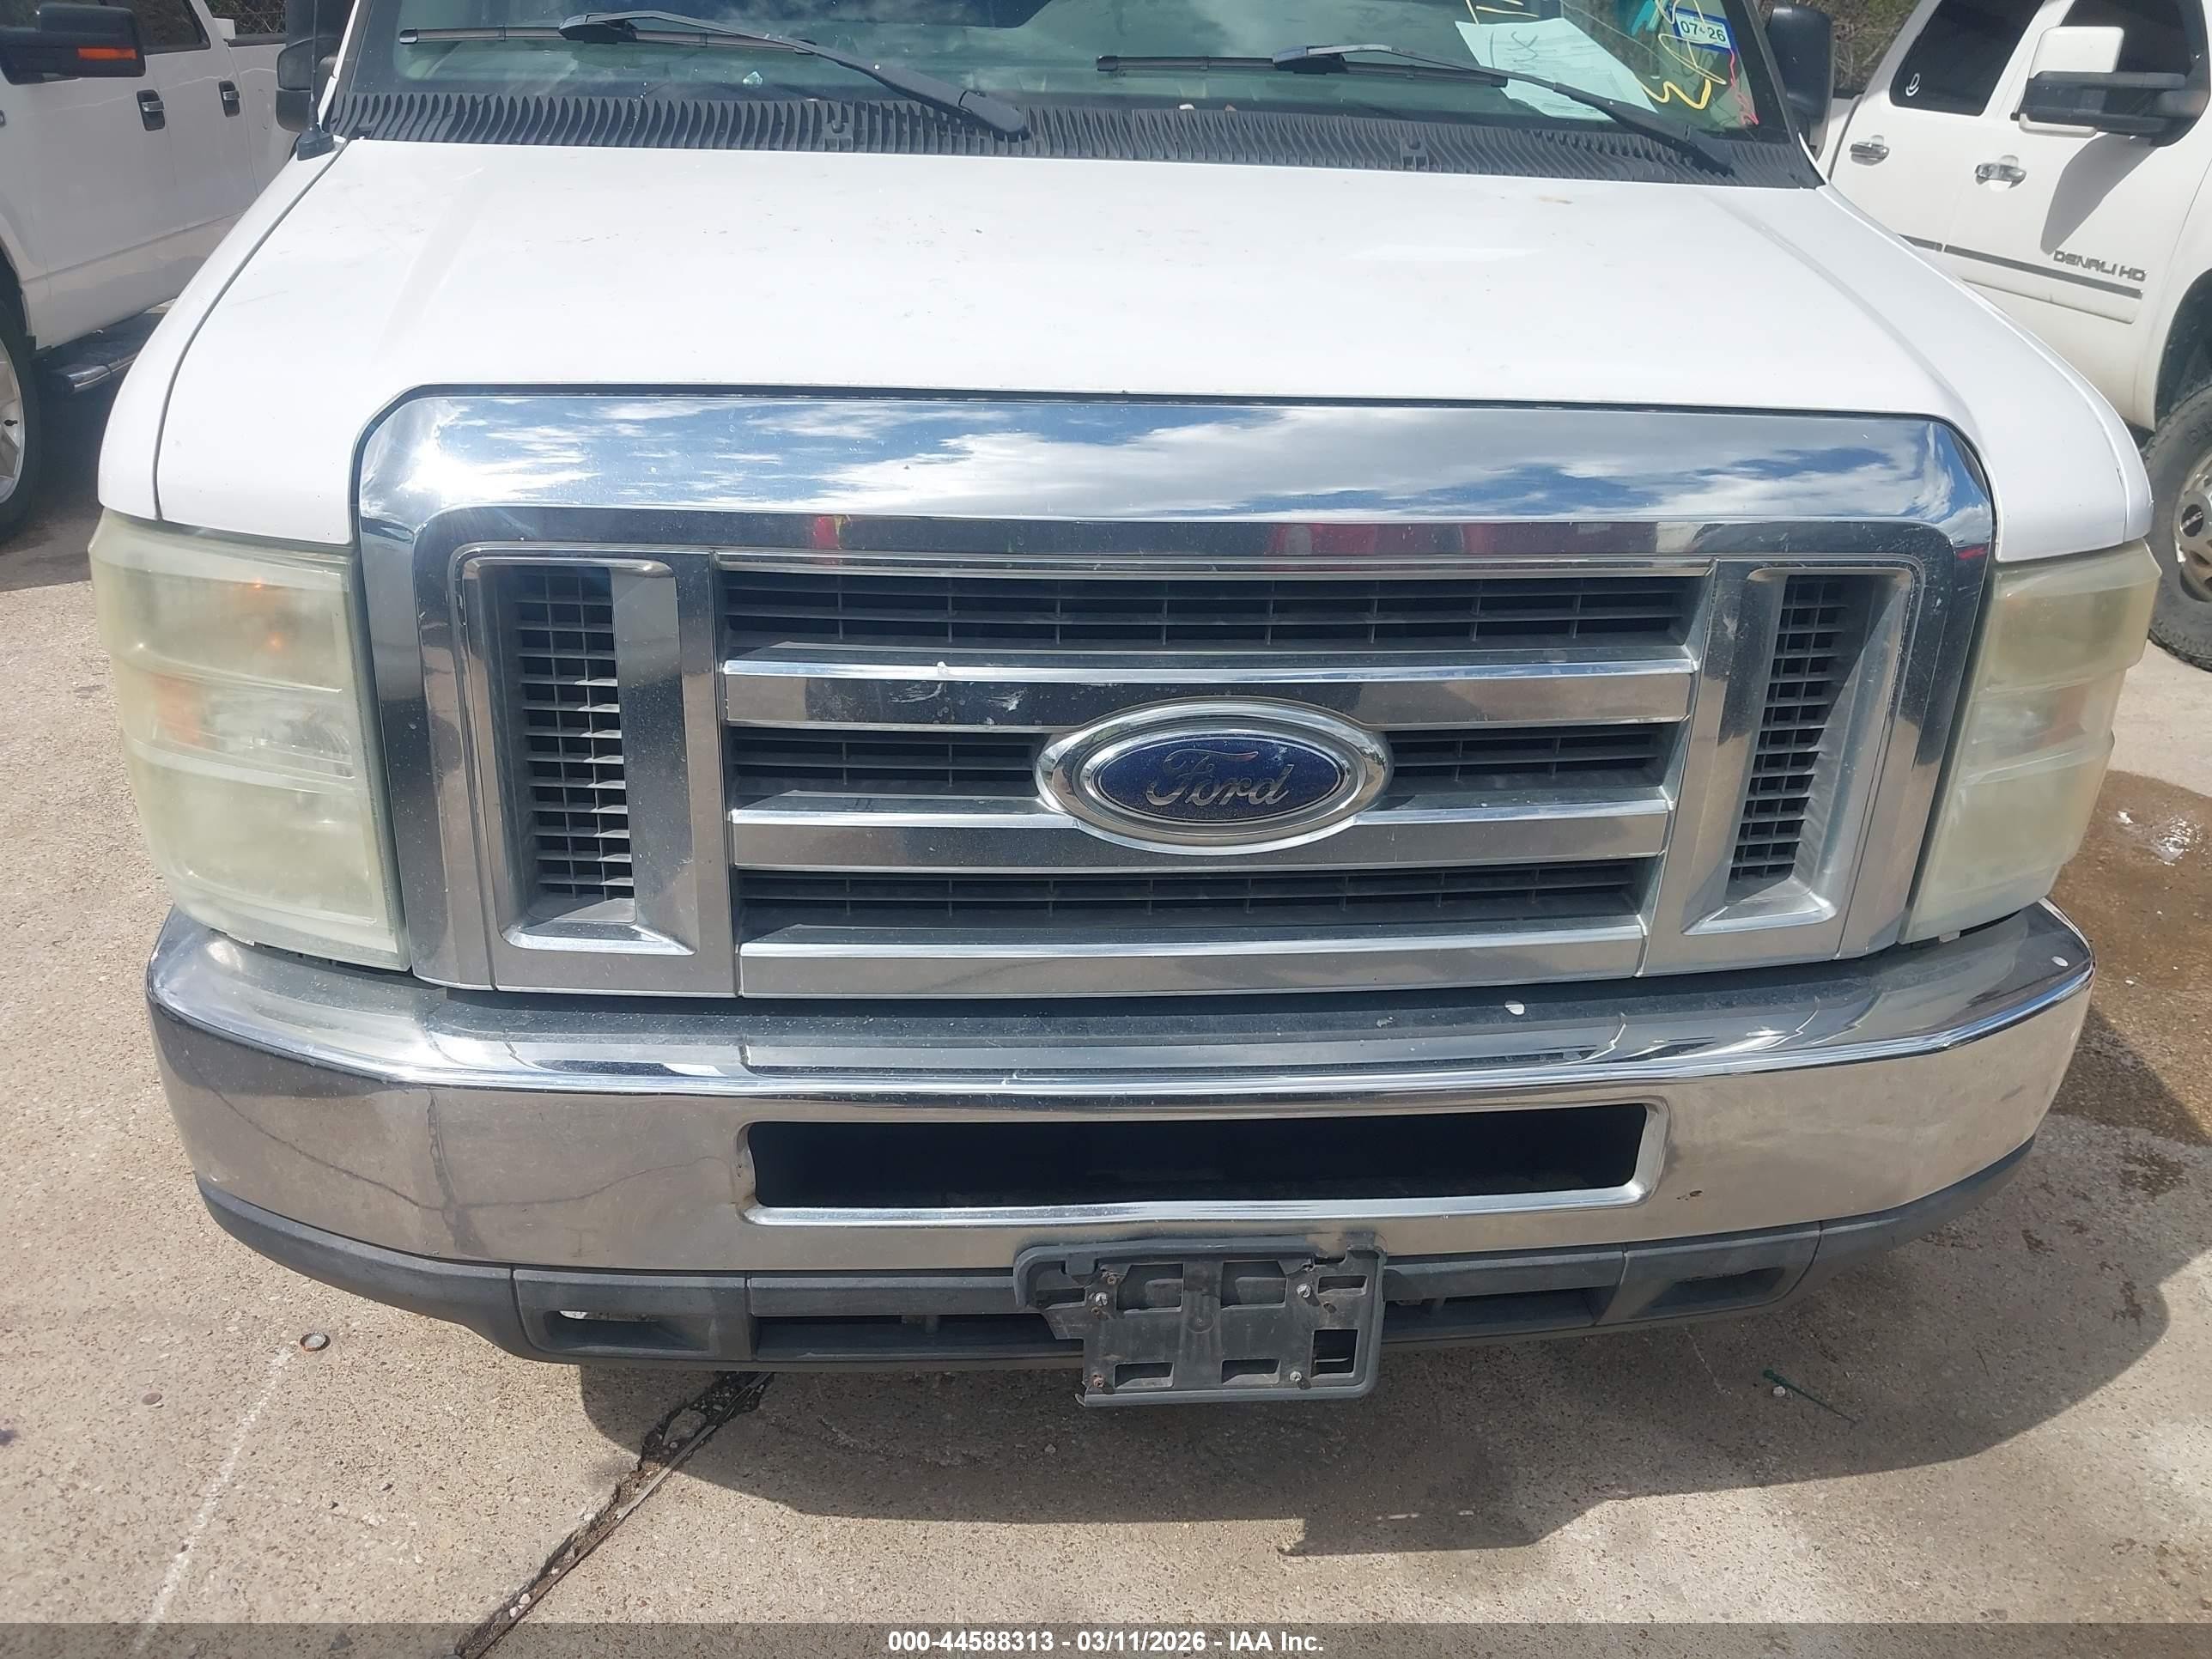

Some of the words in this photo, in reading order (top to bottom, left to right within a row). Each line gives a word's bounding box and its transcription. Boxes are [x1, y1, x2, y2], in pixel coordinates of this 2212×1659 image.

[1680, 21, 1698, 35] 07
[1707, 27, 1726, 42] 26
[2053, 250, 2117, 275] DENALI
[2118, 264, 2147, 282] HD
[1146, 747, 1293, 806] Ford
